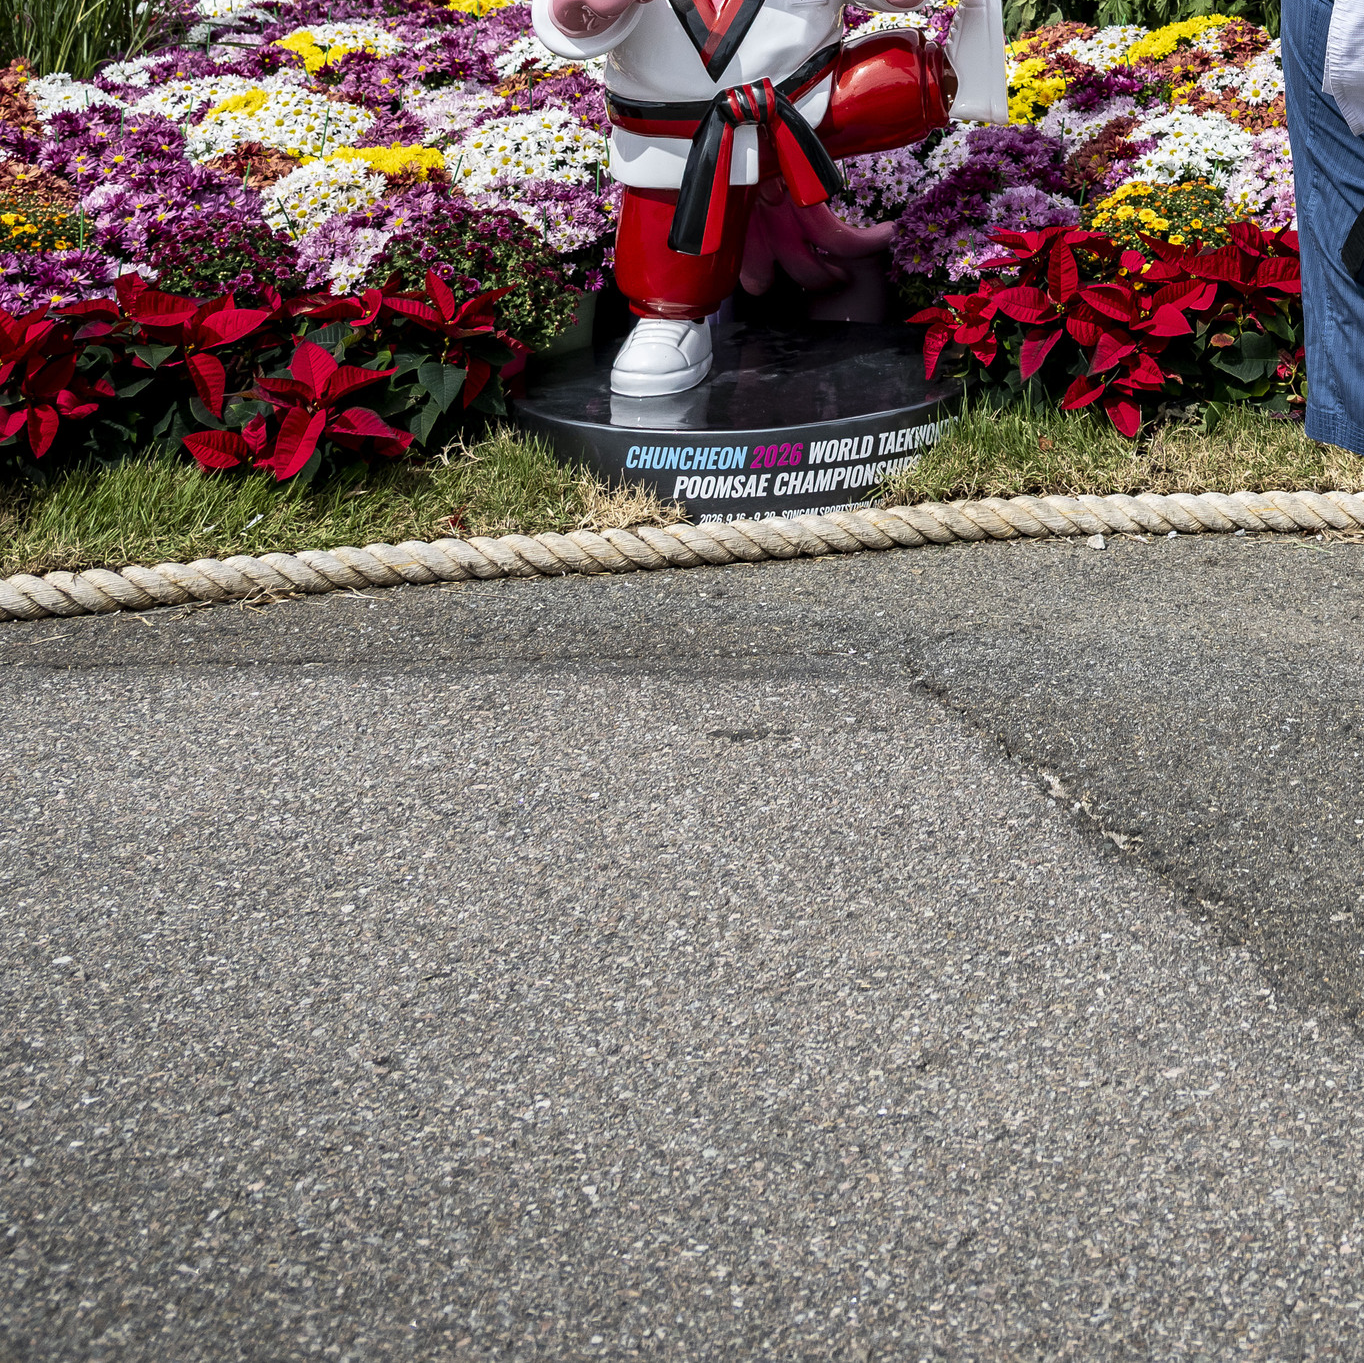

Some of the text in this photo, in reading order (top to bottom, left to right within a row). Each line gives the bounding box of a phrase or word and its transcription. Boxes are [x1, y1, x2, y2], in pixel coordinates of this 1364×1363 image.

[625, 415, 960, 470] CHUNCHEON 2026 WORLD TAEKWON
[672, 473, 772, 500] POOMSAE
